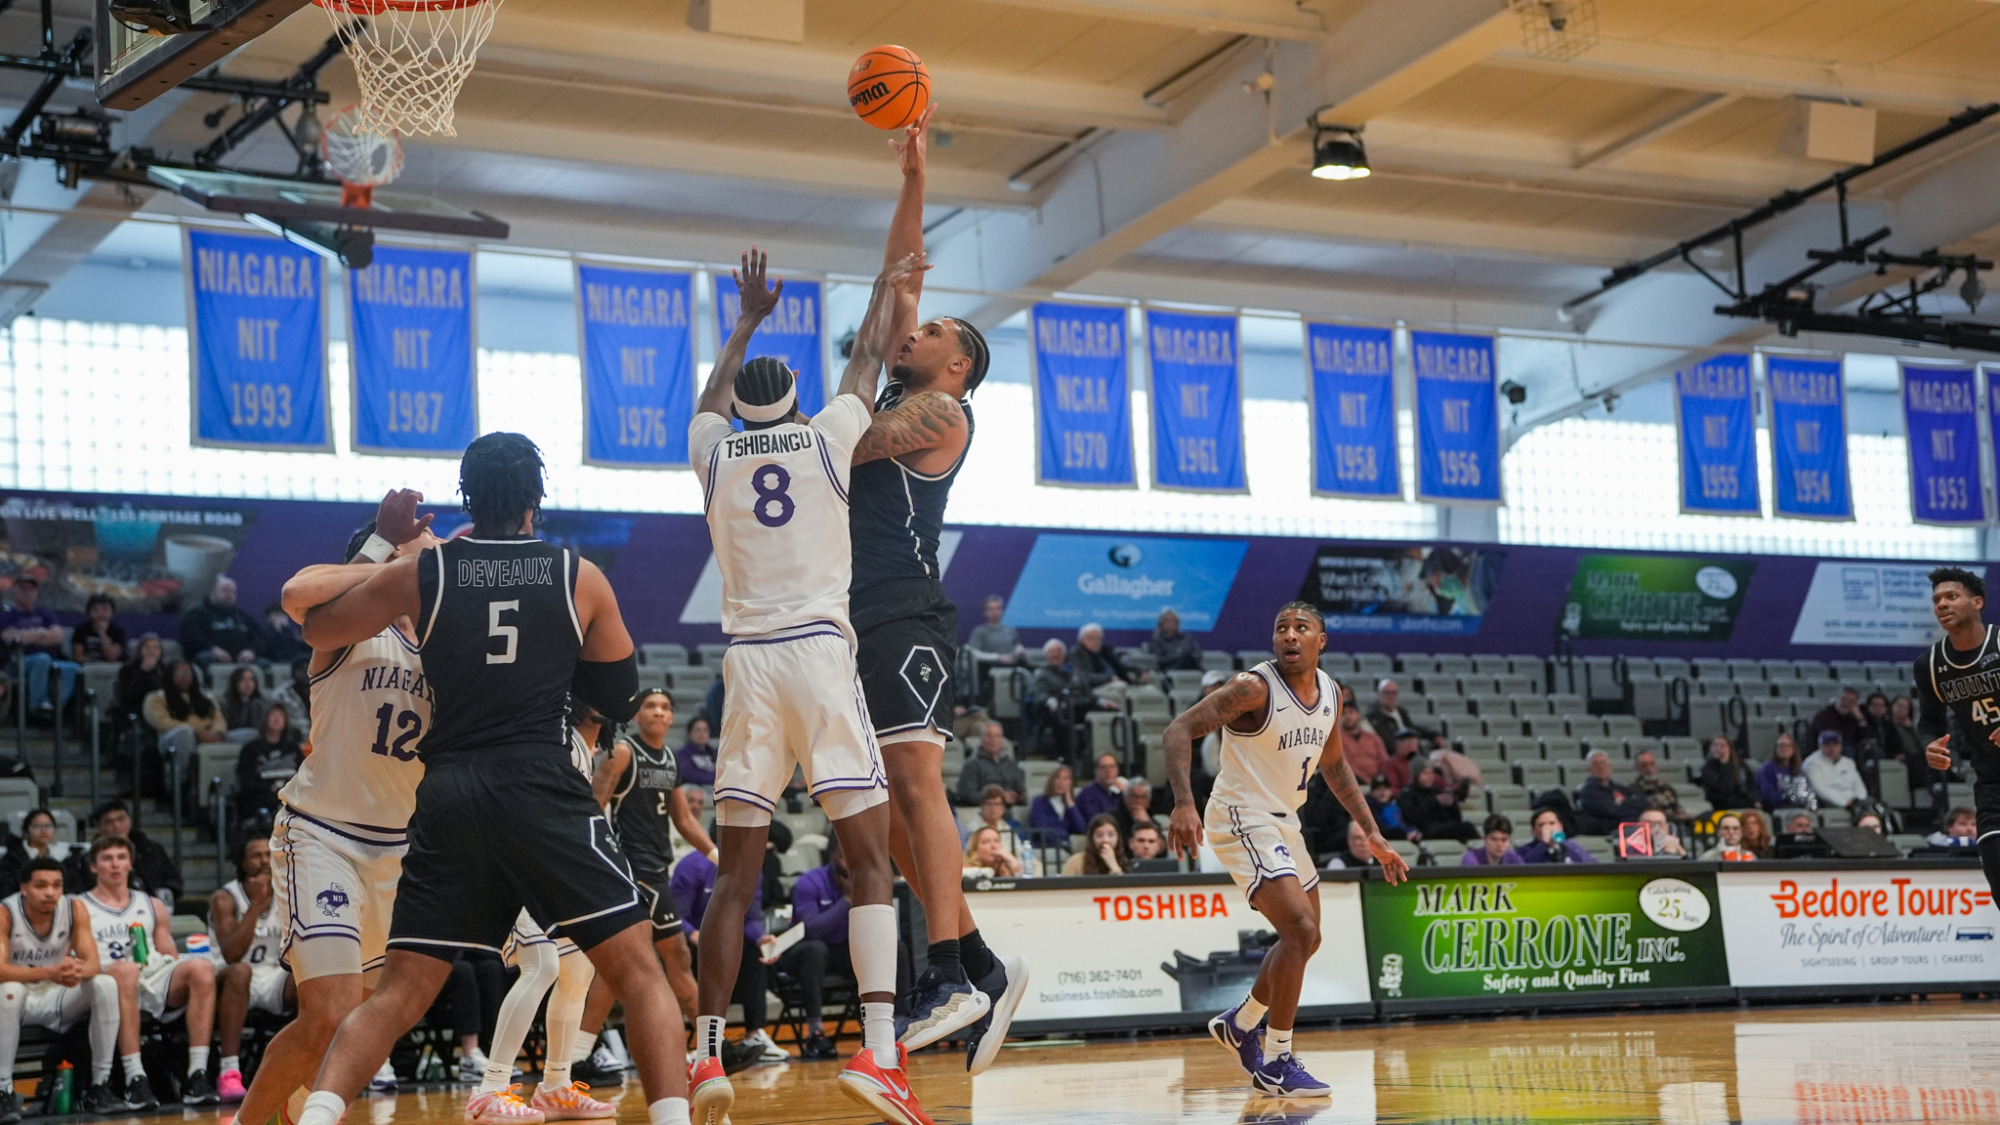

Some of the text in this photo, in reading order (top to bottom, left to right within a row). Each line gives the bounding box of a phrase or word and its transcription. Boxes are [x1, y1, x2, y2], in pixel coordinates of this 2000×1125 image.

[200, 248, 314, 298] NIAGARA
[356, 264, 463, 309] NIAGARA
[587, 283, 687, 327] NIAGARA
[723, 293, 816, 336] NGARA
[238, 318, 279, 362] NIT
[393, 328, 431, 369] NIT
[1038, 318, 1121, 358] NIAGARA
[1153, 326, 1233, 366] NIAGARA
[621, 348, 656, 386] NIT
[1314, 337, 1389, 376] NIAGARA
[1417, 344, 1490, 383] NIAGARA
[1057, 375, 1109, 413] NCAA
[1681, 365, 1746, 398] NIAGARA
[1773, 370, 1839, 406] NIAGARA
[1909, 380, 1973, 413] NIAGARA
[232, 383, 292, 428] 1993
[389, 390, 442, 434] 1987
[1180, 384, 1210, 418] NIT
[1339, 392, 1367, 427] NIT
[1442, 398, 1469, 433] NIT
[618, 406, 667, 448] 1976
[1703, 415, 1728, 448] NIT
[1795, 421, 1820, 454] NIT
[1931, 428, 1955, 461] NIT
[726, 432, 812, 459] TSHIBANGU
[1063, 431, 1108, 469] 1970
[1178, 438, 1219, 473] 1961
[1336, 444, 1377, 481] 1958
[1439, 450, 1481, 487] 1956
[1702, 463, 1738, 499] 1955
[1793, 469, 1831, 503] 1954
[751, 463, 796, 528] 8
[1928, 476, 1968, 510] 1953
[458, 557, 553, 588] DEVEAUX
[1078, 572, 1175, 599] Gallagher
[486, 599, 519, 665] 5
[361, 666, 432, 702] NIAGA
[1972, 697, 2000, 726] 45
[371, 702, 422, 762] 12
[1277, 727, 1328, 751] NIAGAR
[1296, 756, 1312, 791] 1
[656, 791, 667, 815] 2
[1093, 892, 1229, 922] TOSHIBA
[1414, 883, 1517, 916] MARK
[1658, 896, 1681, 919] 25
[1770, 878, 1973, 918] Bedore Tours
[250, 944, 267, 963] 0
[1421, 913, 1686, 974] CERRONE INC.
[1780, 921, 1952, 952] The Spirit of Adventure!
[1058, 969, 1142, 985] (716) 362-7401
[1801, 954, 1984, 967] SIGHTSEEING GROUP TOURS CHARTERS
[1040, 988, 1163, 1003] business.toshiba.com
[1483, 967, 1650, 994] Safety and Quality First
